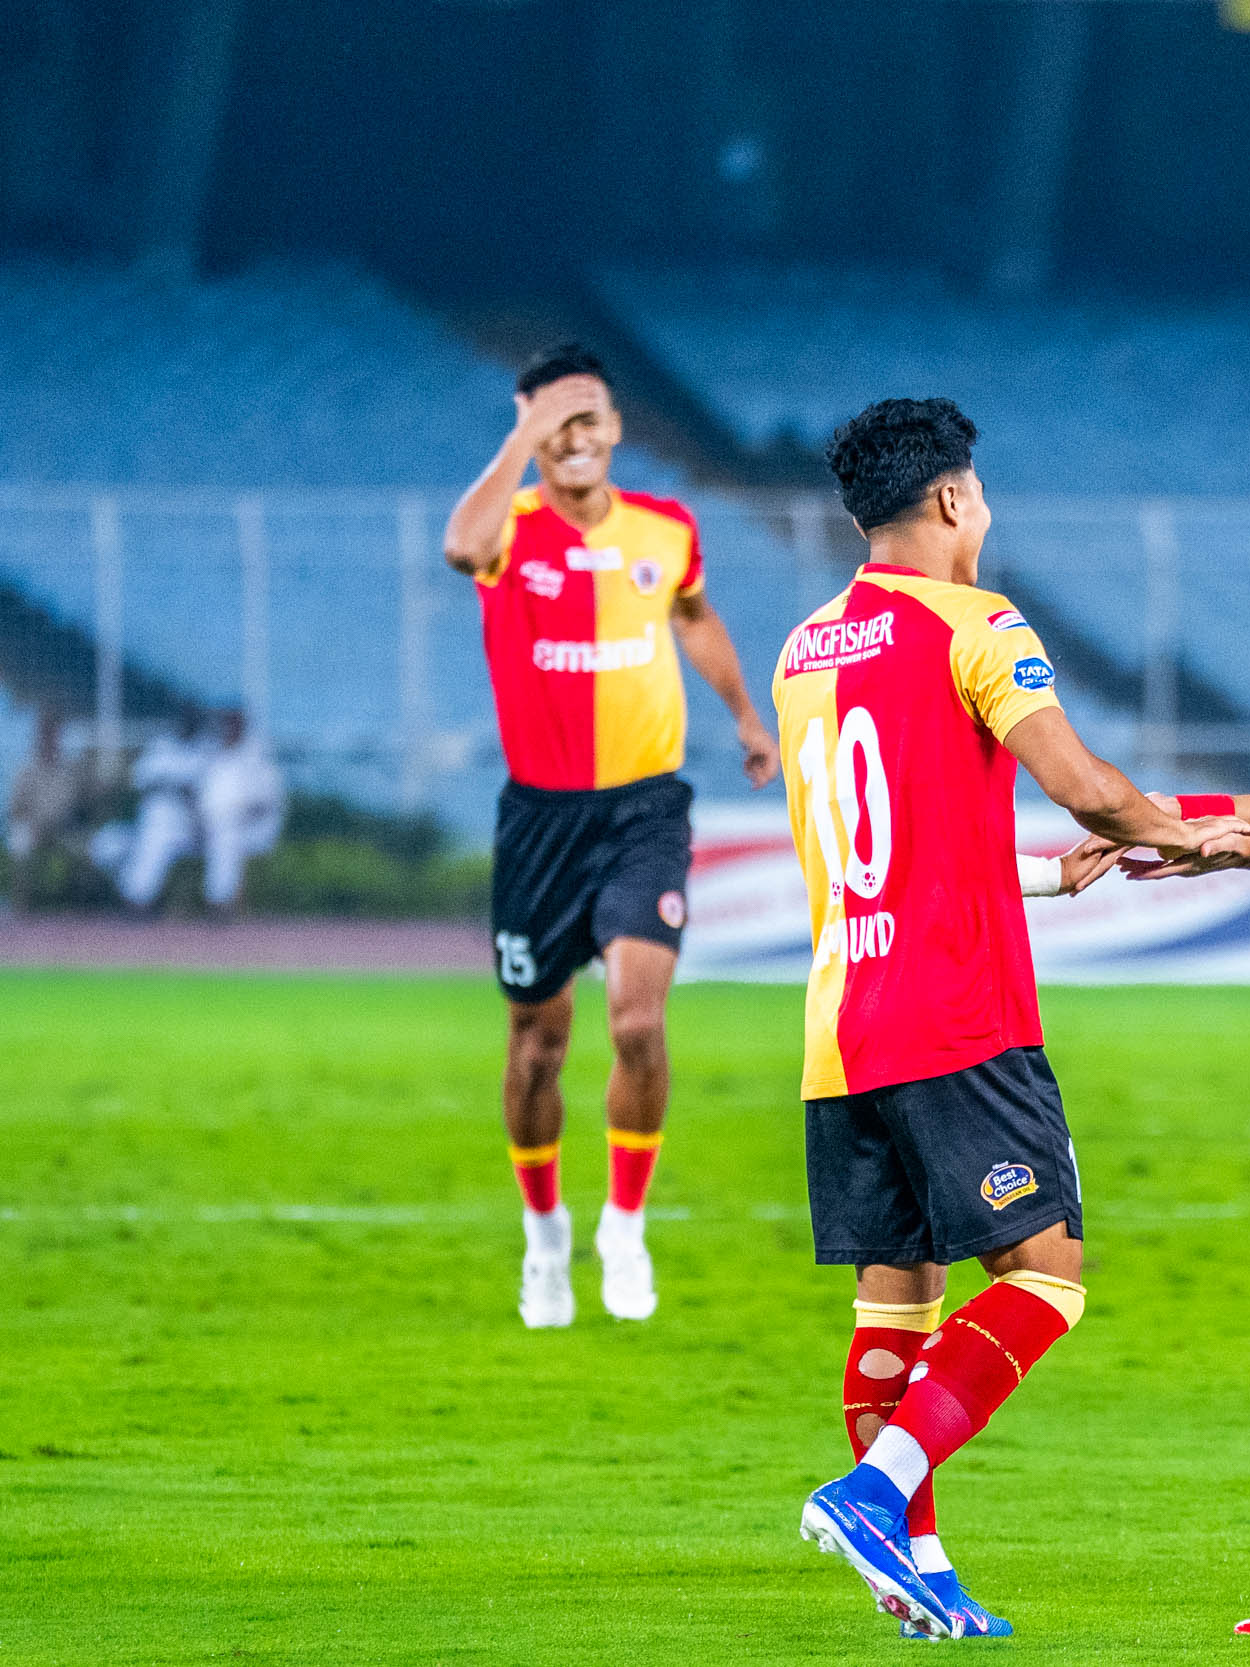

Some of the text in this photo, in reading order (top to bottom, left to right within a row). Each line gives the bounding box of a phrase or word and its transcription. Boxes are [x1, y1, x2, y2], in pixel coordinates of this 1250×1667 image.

[787, 611, 895, 670] KINGFISHER
[803, 646, 881, 671] STRONG POWER SODA
[1017, 666, 1050, 677] TATA
[798, 706, 892, 905] 10
[496, 930, 537, 988] 15
[993, 1169, 1017, 1187] Best
[994, 1177, 1028, 1198] Choice
